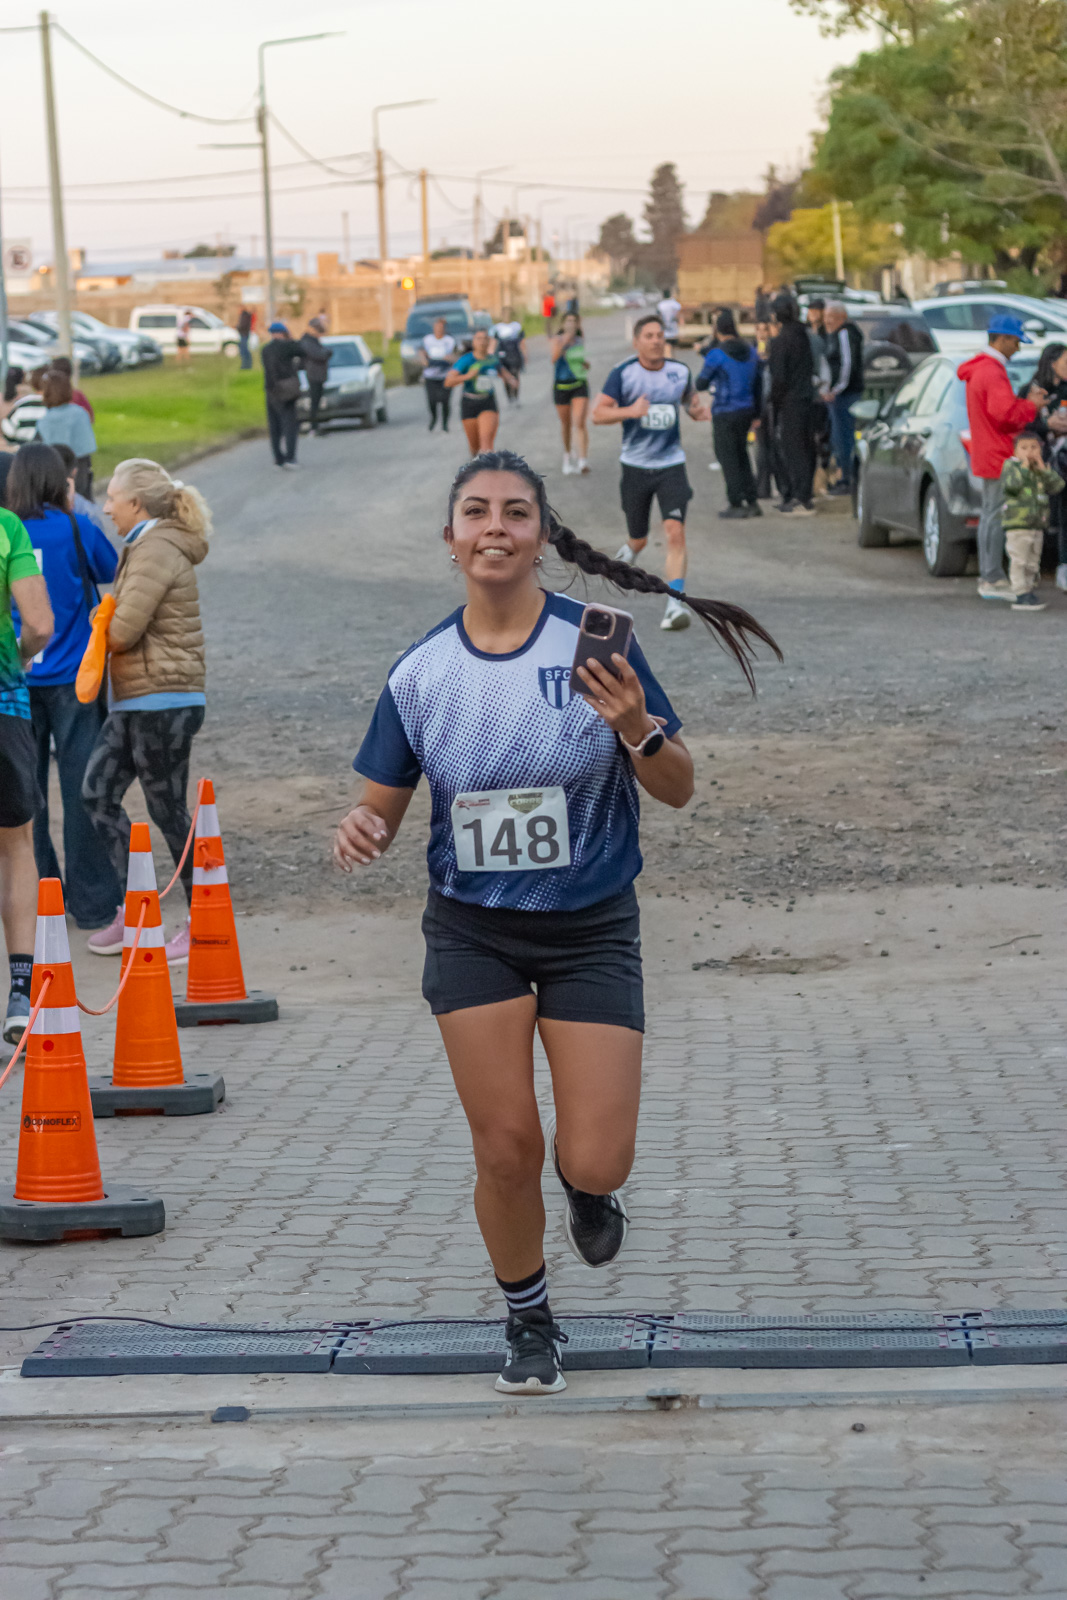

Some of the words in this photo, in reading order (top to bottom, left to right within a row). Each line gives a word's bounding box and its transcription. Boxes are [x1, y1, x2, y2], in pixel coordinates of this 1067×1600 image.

[545, 670, 571, 680] SFC
[462, 815, 560, 867] 148
[31, 1118, 78, 1126] CONOFLEX
